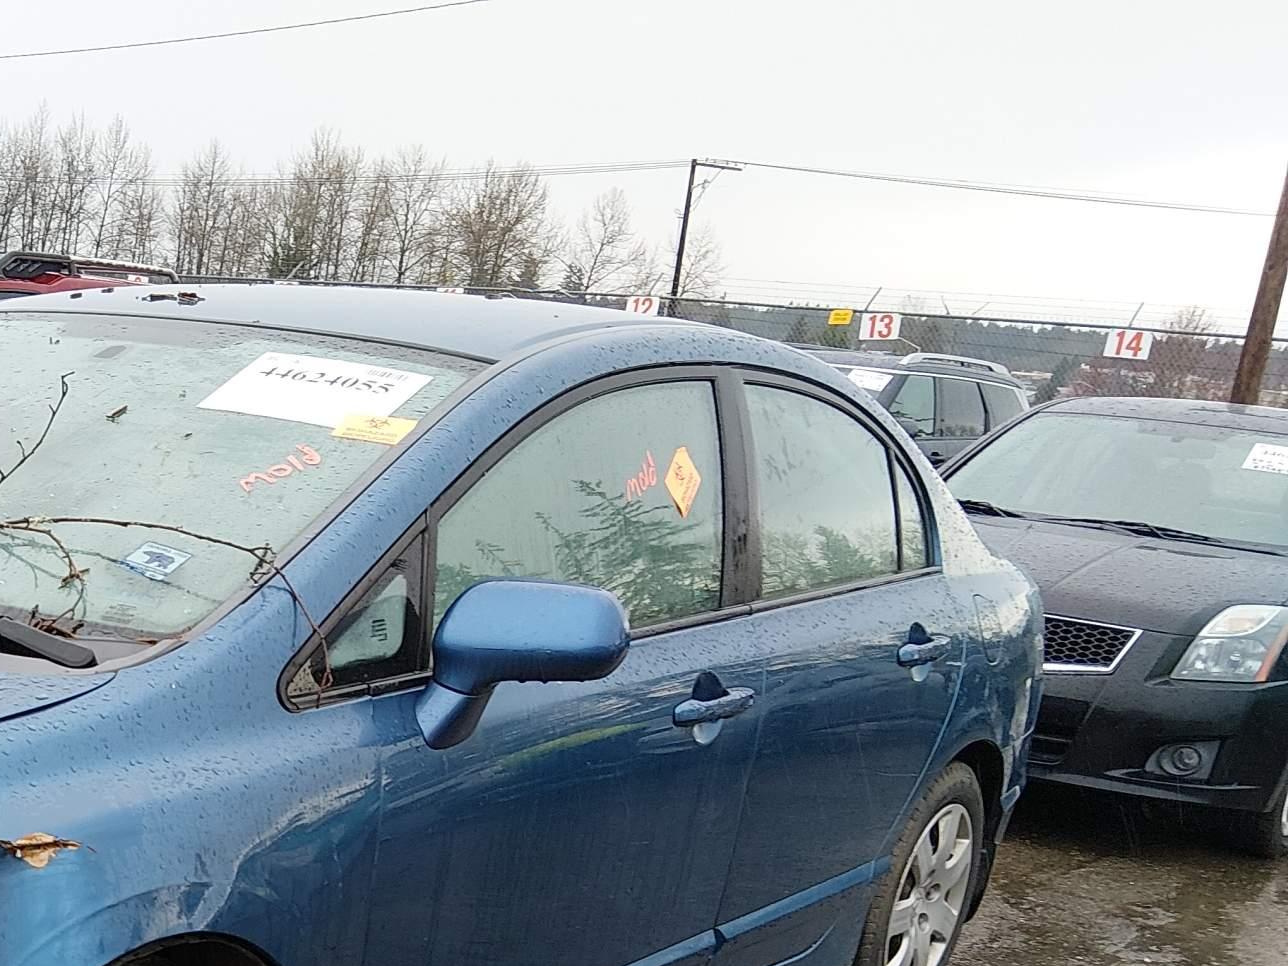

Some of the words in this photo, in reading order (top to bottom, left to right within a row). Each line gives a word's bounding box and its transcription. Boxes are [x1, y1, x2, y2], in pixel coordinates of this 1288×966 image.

[632, 297, 654, 314] 12
[868, 314, 894, 339] 13
[1114, 330, 1144, 357] 14
[259, 366, 395, 394] 44624055
